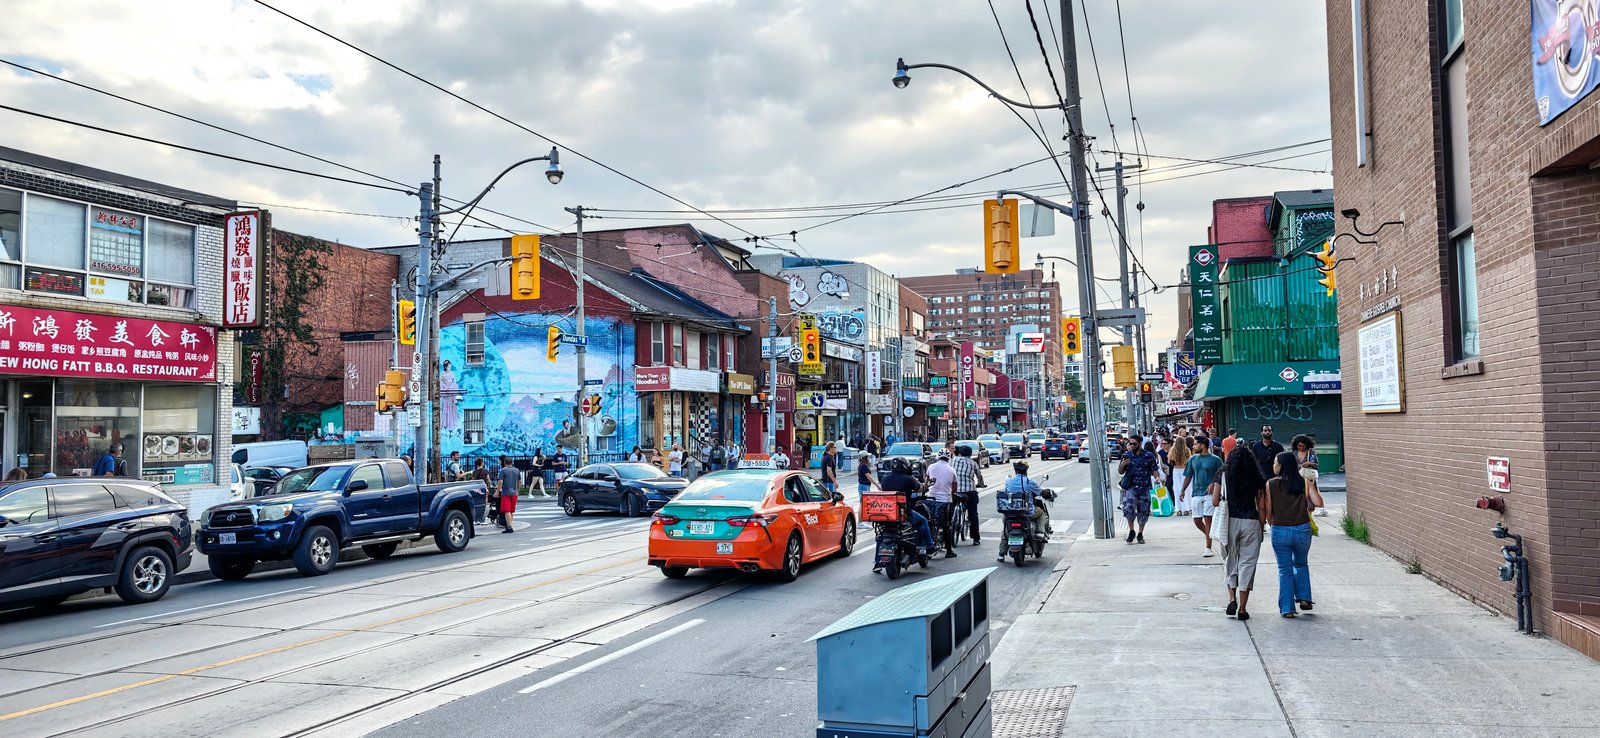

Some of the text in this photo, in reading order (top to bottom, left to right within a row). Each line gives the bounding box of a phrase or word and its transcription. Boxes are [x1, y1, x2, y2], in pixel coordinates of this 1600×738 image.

[232, 282, 250, 324] 飯店
[1198, 272, 1214, 333] 天仁茗茶
[562, 335, 578, 343] Dundas
[184, 352, 210, 363] 风味小炒
[0, 357, 198, 377] EW HONG FATT B.B.Q. RESTAURANT
[765, 373, 779, 384] CE
